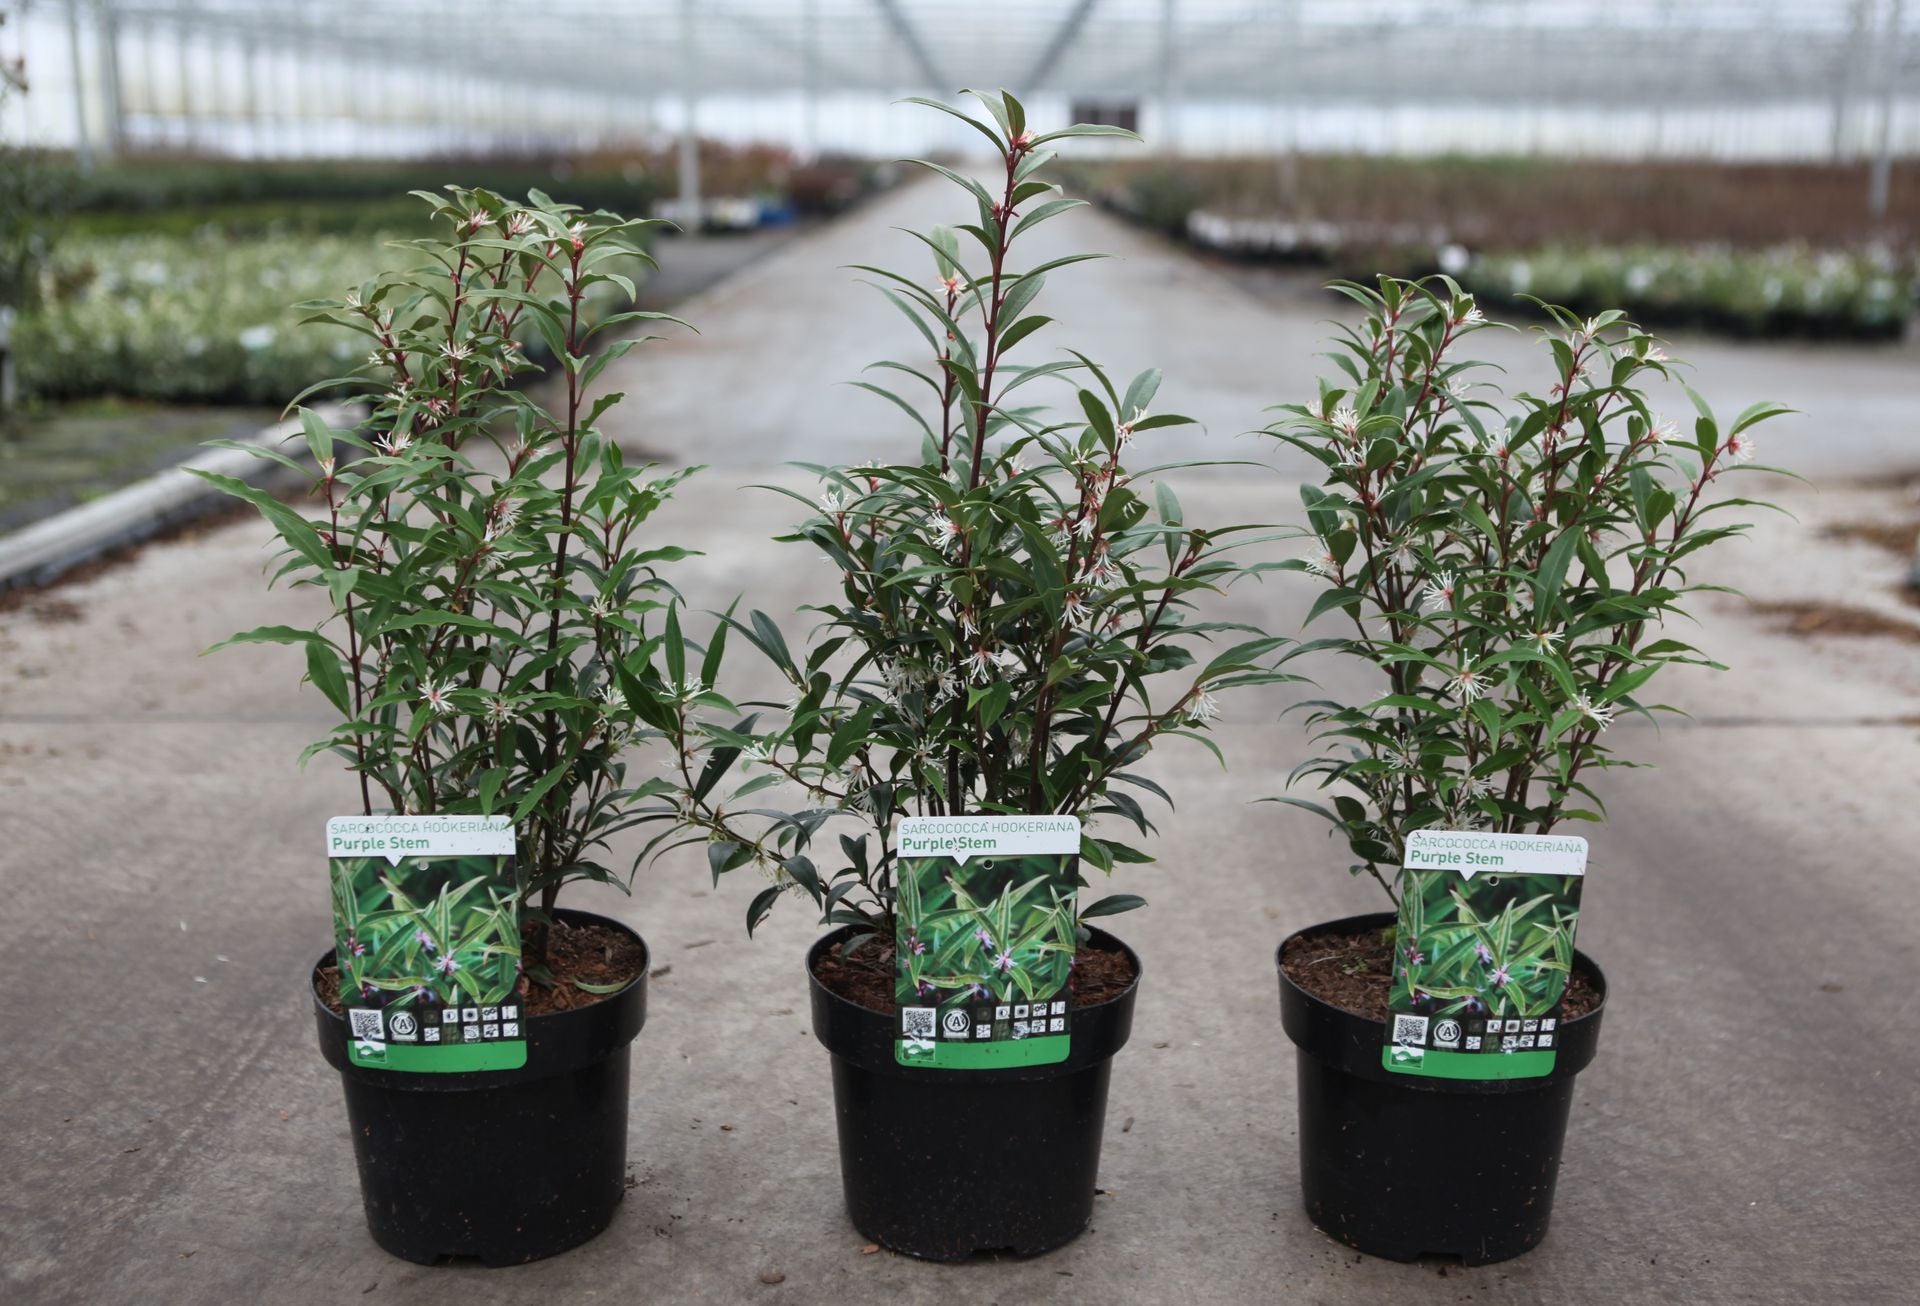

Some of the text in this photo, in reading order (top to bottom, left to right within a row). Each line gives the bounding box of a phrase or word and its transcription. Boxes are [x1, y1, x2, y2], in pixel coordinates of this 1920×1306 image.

[331, 821, 510, 834] SARCOCOCCA HOOKERIANA
[902, 821, 1075, 835] SARCOCOCCA HOOKERIANA
[333, 837, 430, 852] Purple Stem
[902, 836, 997, 852] Purple Stem
[1411, 837, 1583, 854] SARCOCOCCA HOOKERIANA
[1410, 850, 1504, 866] Purple Stem
